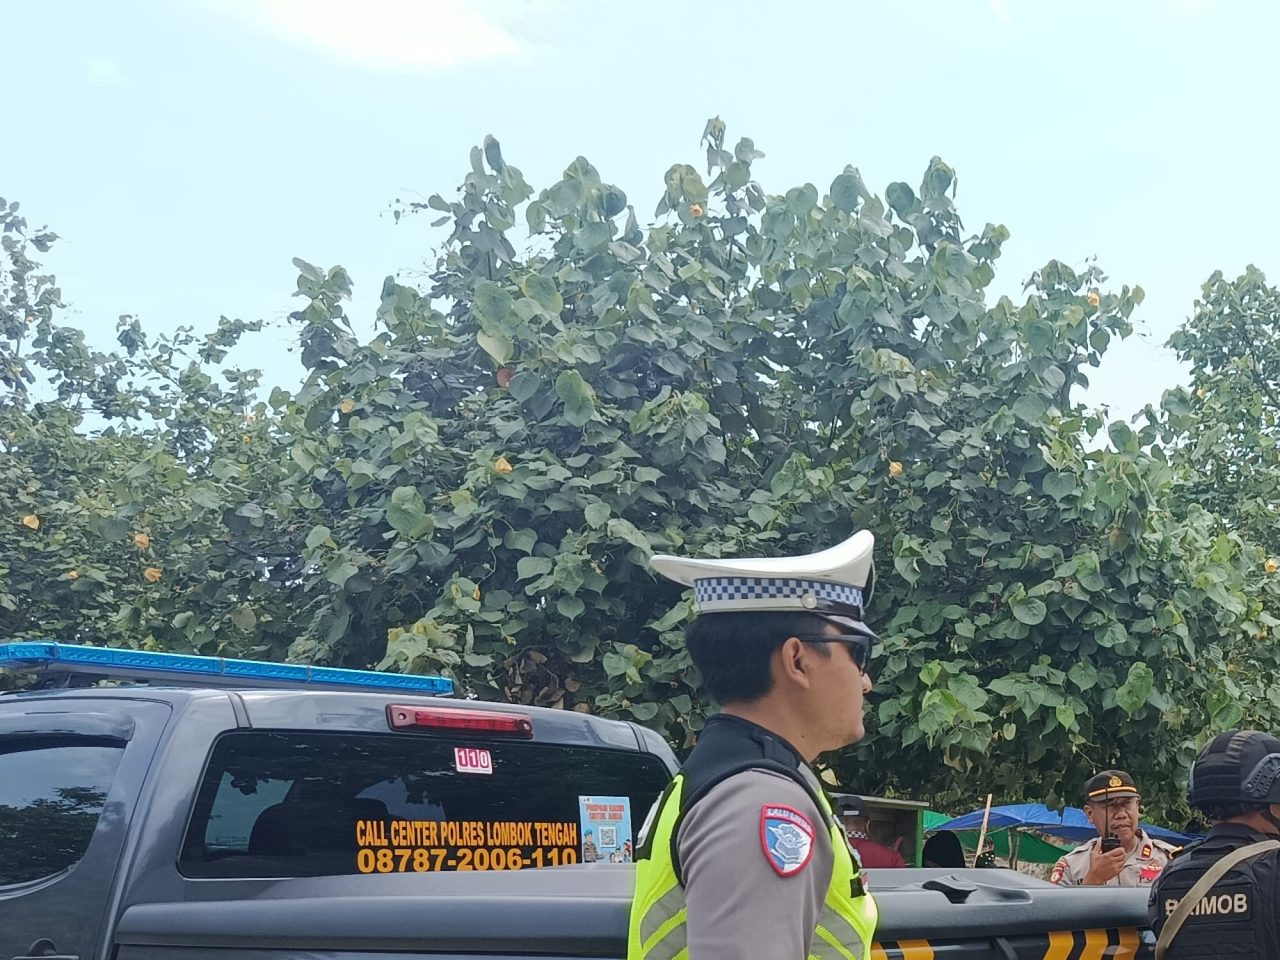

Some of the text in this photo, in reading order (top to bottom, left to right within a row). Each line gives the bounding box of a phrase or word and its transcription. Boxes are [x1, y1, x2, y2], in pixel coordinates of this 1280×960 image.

[458, 750, 489, 768] 110
[356, 820, 577, 846] CALL CENTER POLRES LOMBOK TENGAH
[357, 847, 577, 873] 08787-2006-110
[1165, 893, 1248, 916] BIMOB
